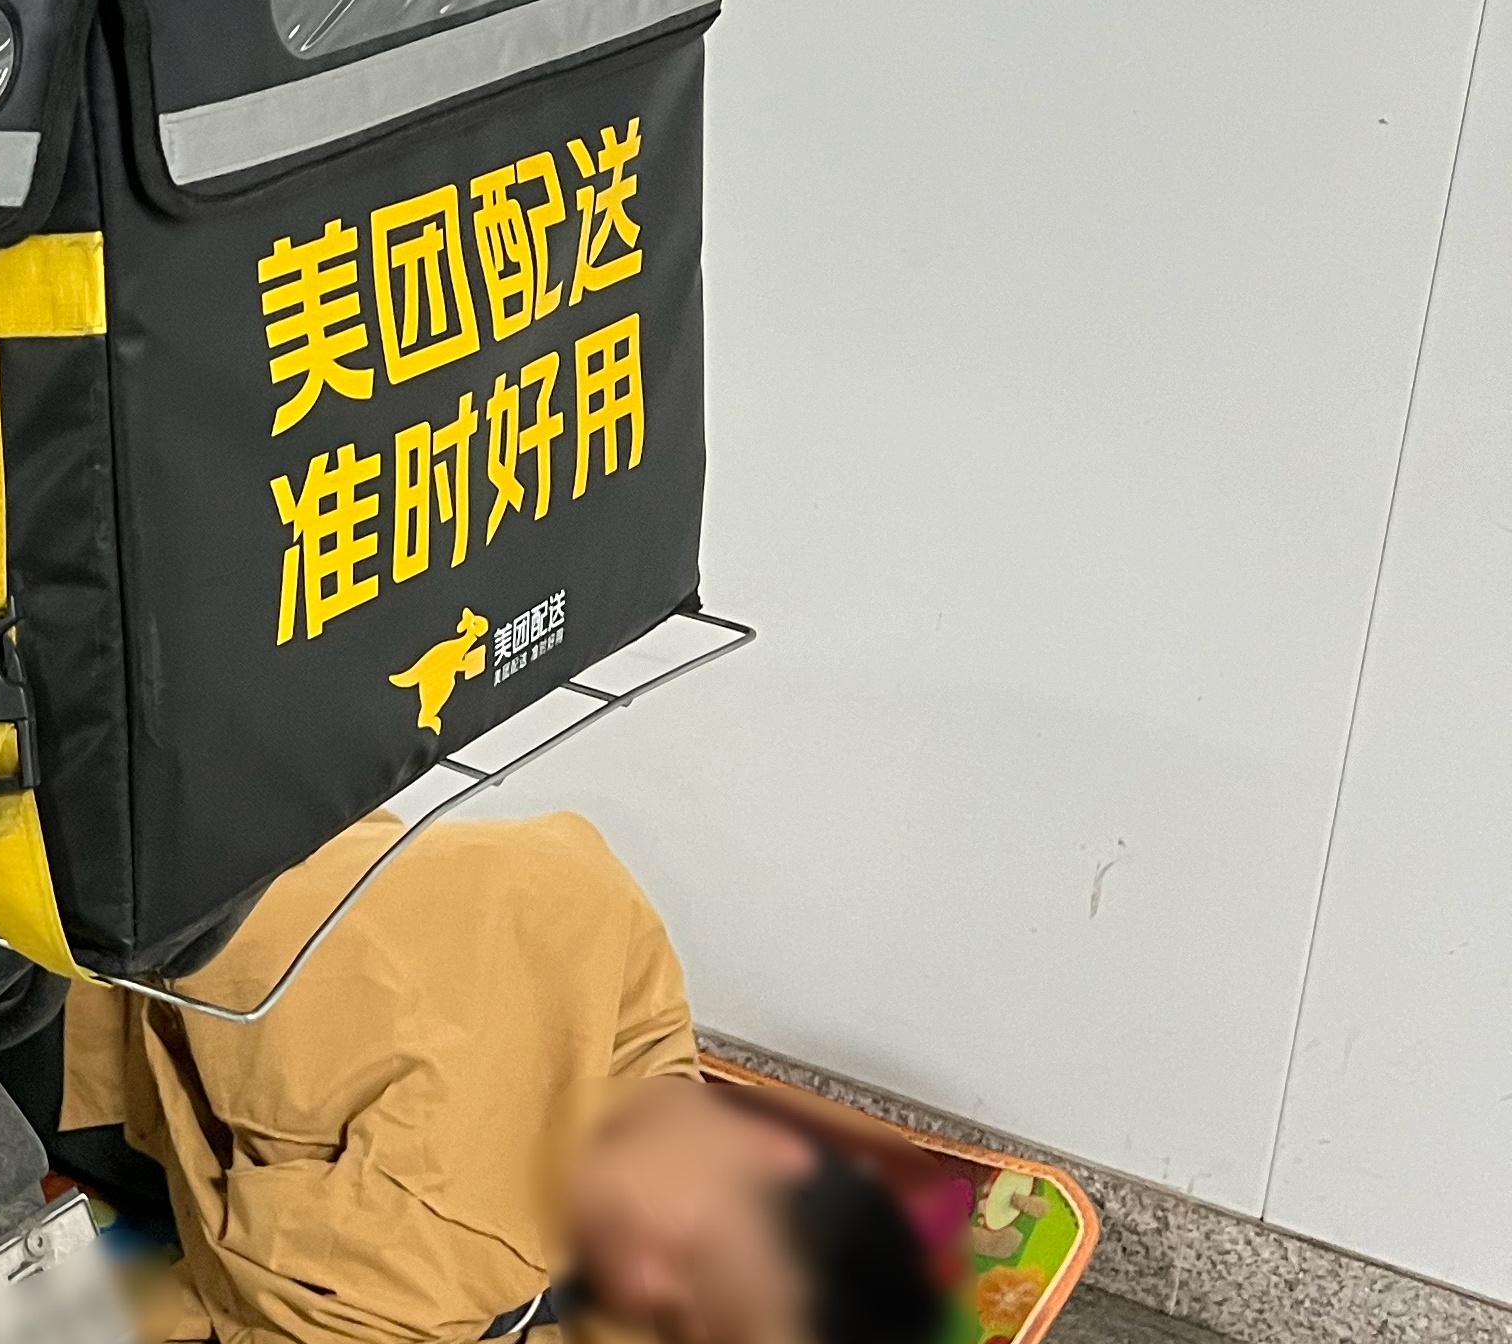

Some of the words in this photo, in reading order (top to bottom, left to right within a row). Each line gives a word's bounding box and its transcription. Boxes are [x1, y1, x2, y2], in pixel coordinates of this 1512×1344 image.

[257, 117, 643, 437] 美团配送
[269, 312, 645, 646] 准时好用
[493, 588, 566, 667] 美团配送
